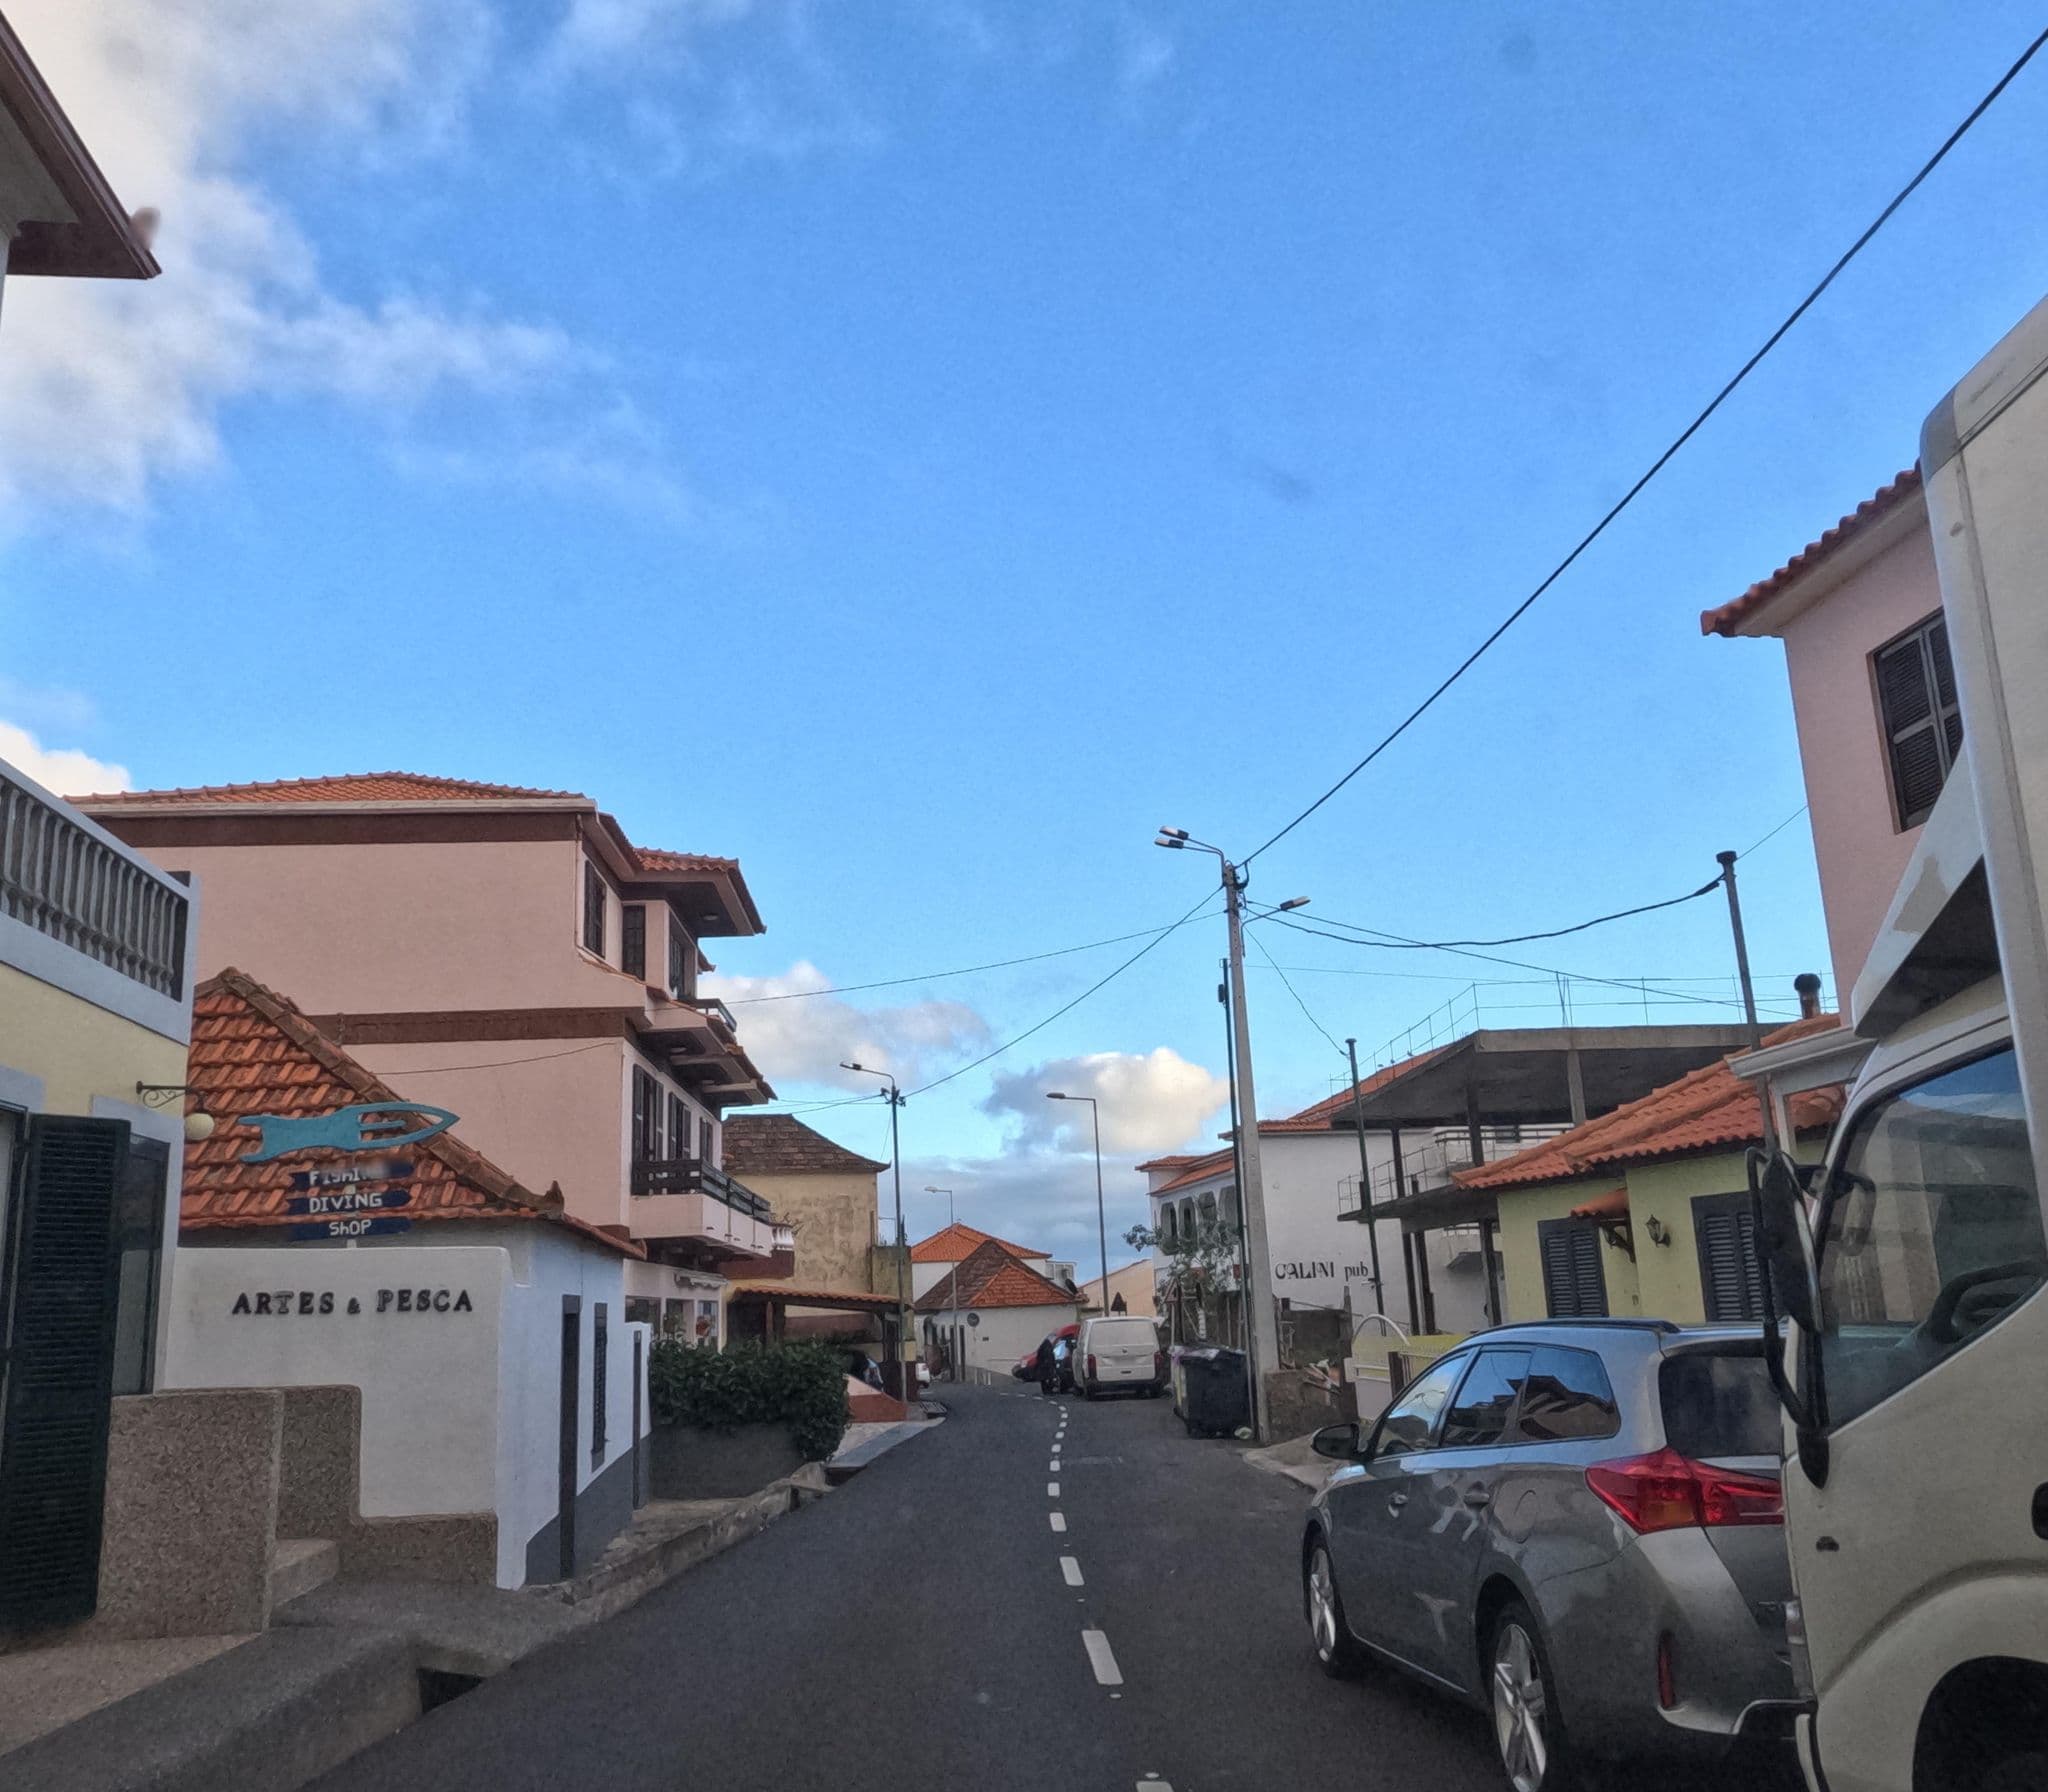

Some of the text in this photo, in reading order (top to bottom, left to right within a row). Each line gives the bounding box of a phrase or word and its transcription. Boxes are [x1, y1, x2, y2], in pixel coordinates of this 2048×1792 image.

[309, 1193, 383, 1213] DIVING
[1344, 1261, 1369, 1282] pub
[231, 1289, 473, 1315] ARTES & PESCA
